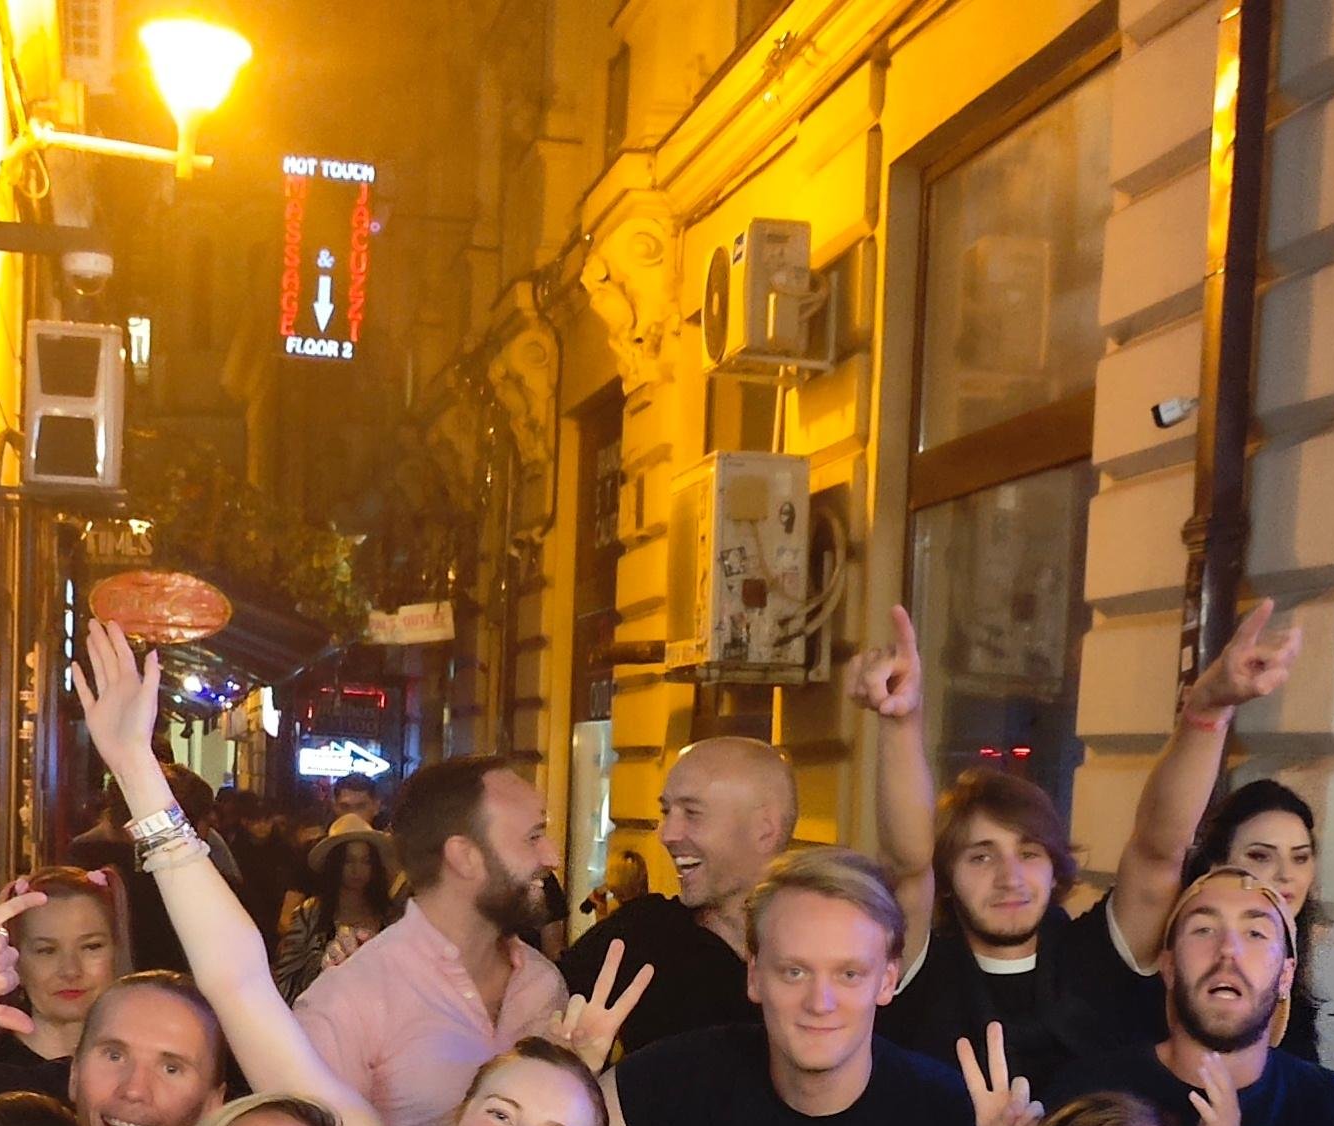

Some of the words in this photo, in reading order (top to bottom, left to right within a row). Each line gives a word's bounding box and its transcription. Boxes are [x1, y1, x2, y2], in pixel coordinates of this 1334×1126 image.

[283, 156, 317, 176] HOT
[321, 160, 375, 183] TOUCH
[280, 175, 307, 336] MASSAGE
[347, 182, 371, 342] JACUZZI
[285, 336, 340, 358] FLOOR
[341, 341, 354, 359] 2
